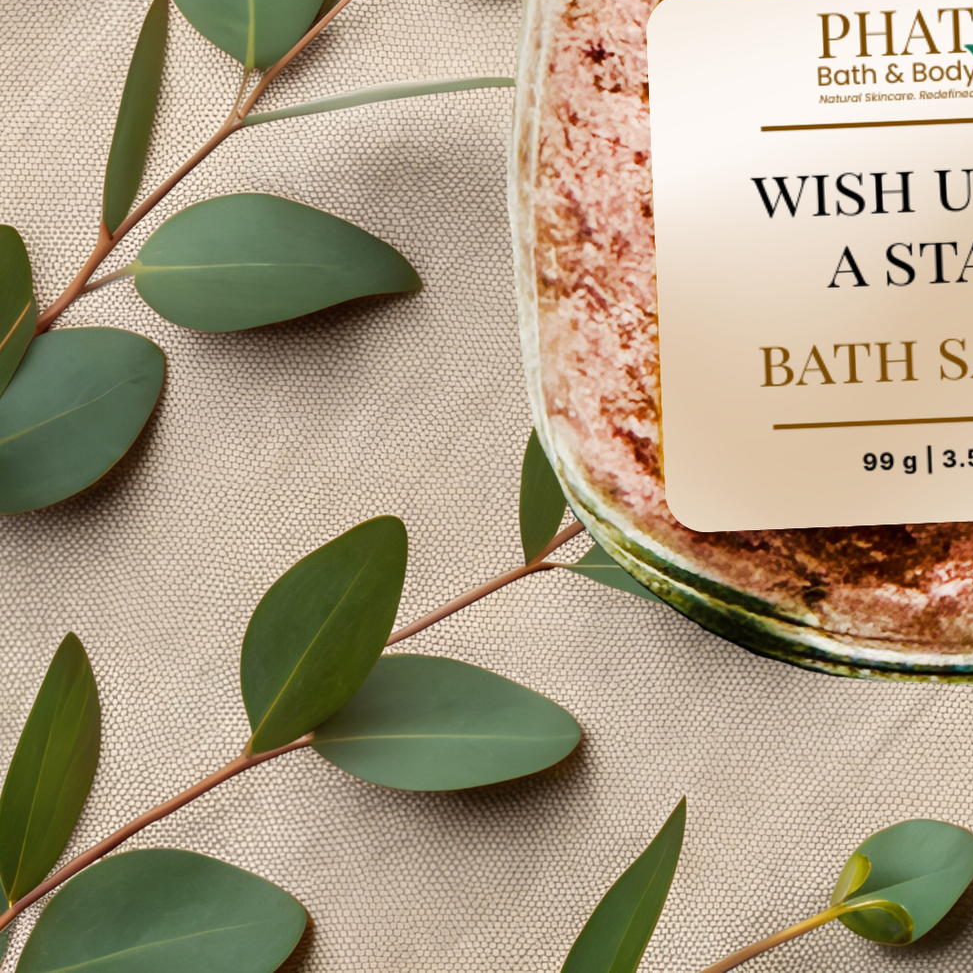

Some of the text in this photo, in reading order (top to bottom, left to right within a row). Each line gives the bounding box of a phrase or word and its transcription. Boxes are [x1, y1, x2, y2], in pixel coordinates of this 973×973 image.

[817, 7, 973, 59] PHAT
[817, 63, 877, 87] Bath
[885, 63, 904, 84] &
[818, 92, 862, 104] Natural
[864, 91, 916, 102] Skincare.
[750, 171, 915, 218] WISH
[827, 245, 870, 288] A
[759, 341, 919, 387] BATH
[863, 452, 895, 472] 99
[903, 455, 917, 474] g
